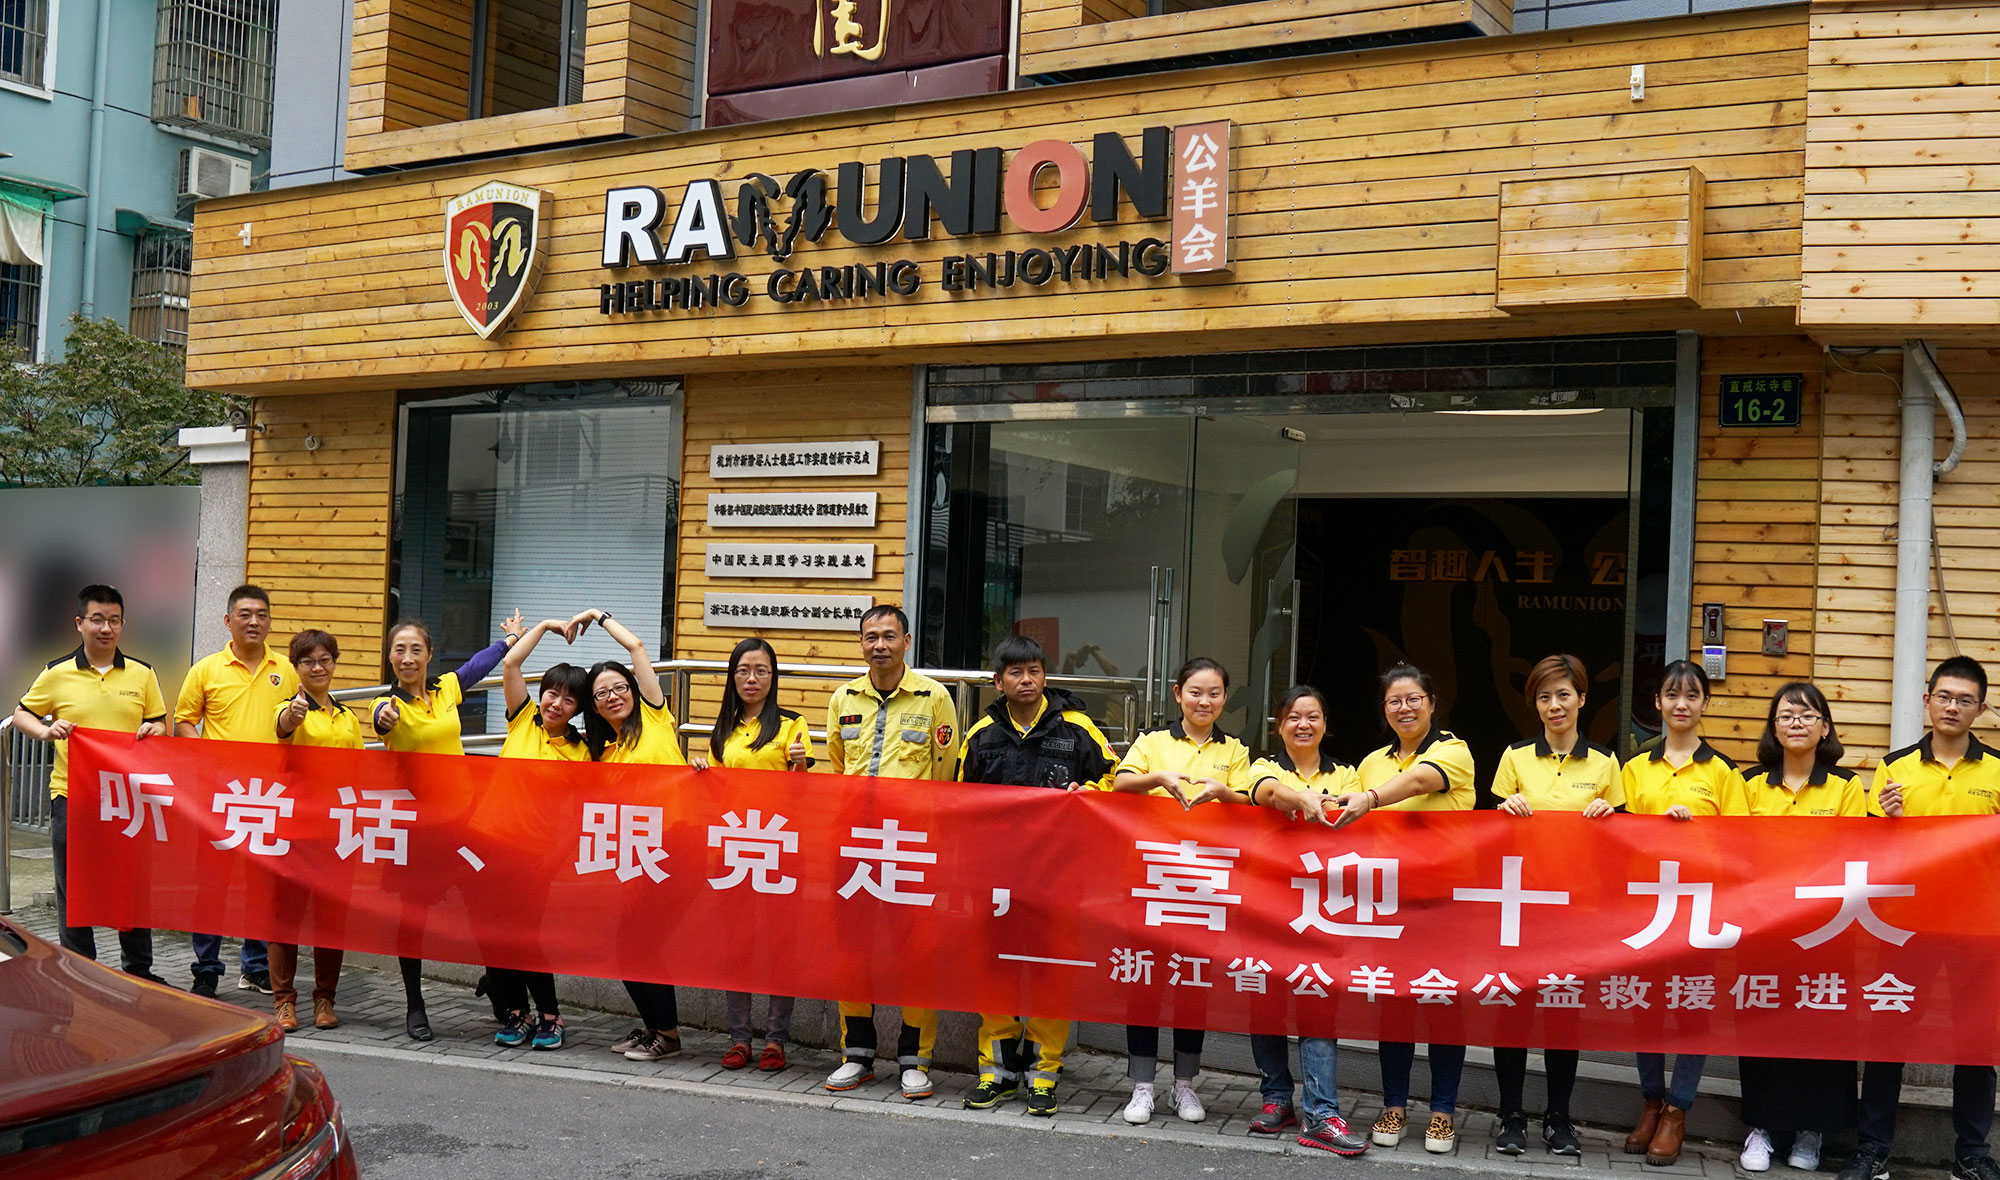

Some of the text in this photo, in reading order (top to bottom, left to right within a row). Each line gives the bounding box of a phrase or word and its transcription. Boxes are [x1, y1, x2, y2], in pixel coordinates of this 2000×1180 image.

[455, 188, 530, 211] RAMUNION
[1180, 132, 1220, 264] 公羊会
[600, 237, 1170, 315] HELPING CARING ENJOYING
[474, 301, 499, 312] 2003
[1729, 379, 1793, 393] 直戒坛寺巷
[1733, 398, 1786, 422] 16-2
[712, 553, 866, 567] 中国民主同盟学习实践基地
[1389, 548, 1554, 584] 智趣人生
